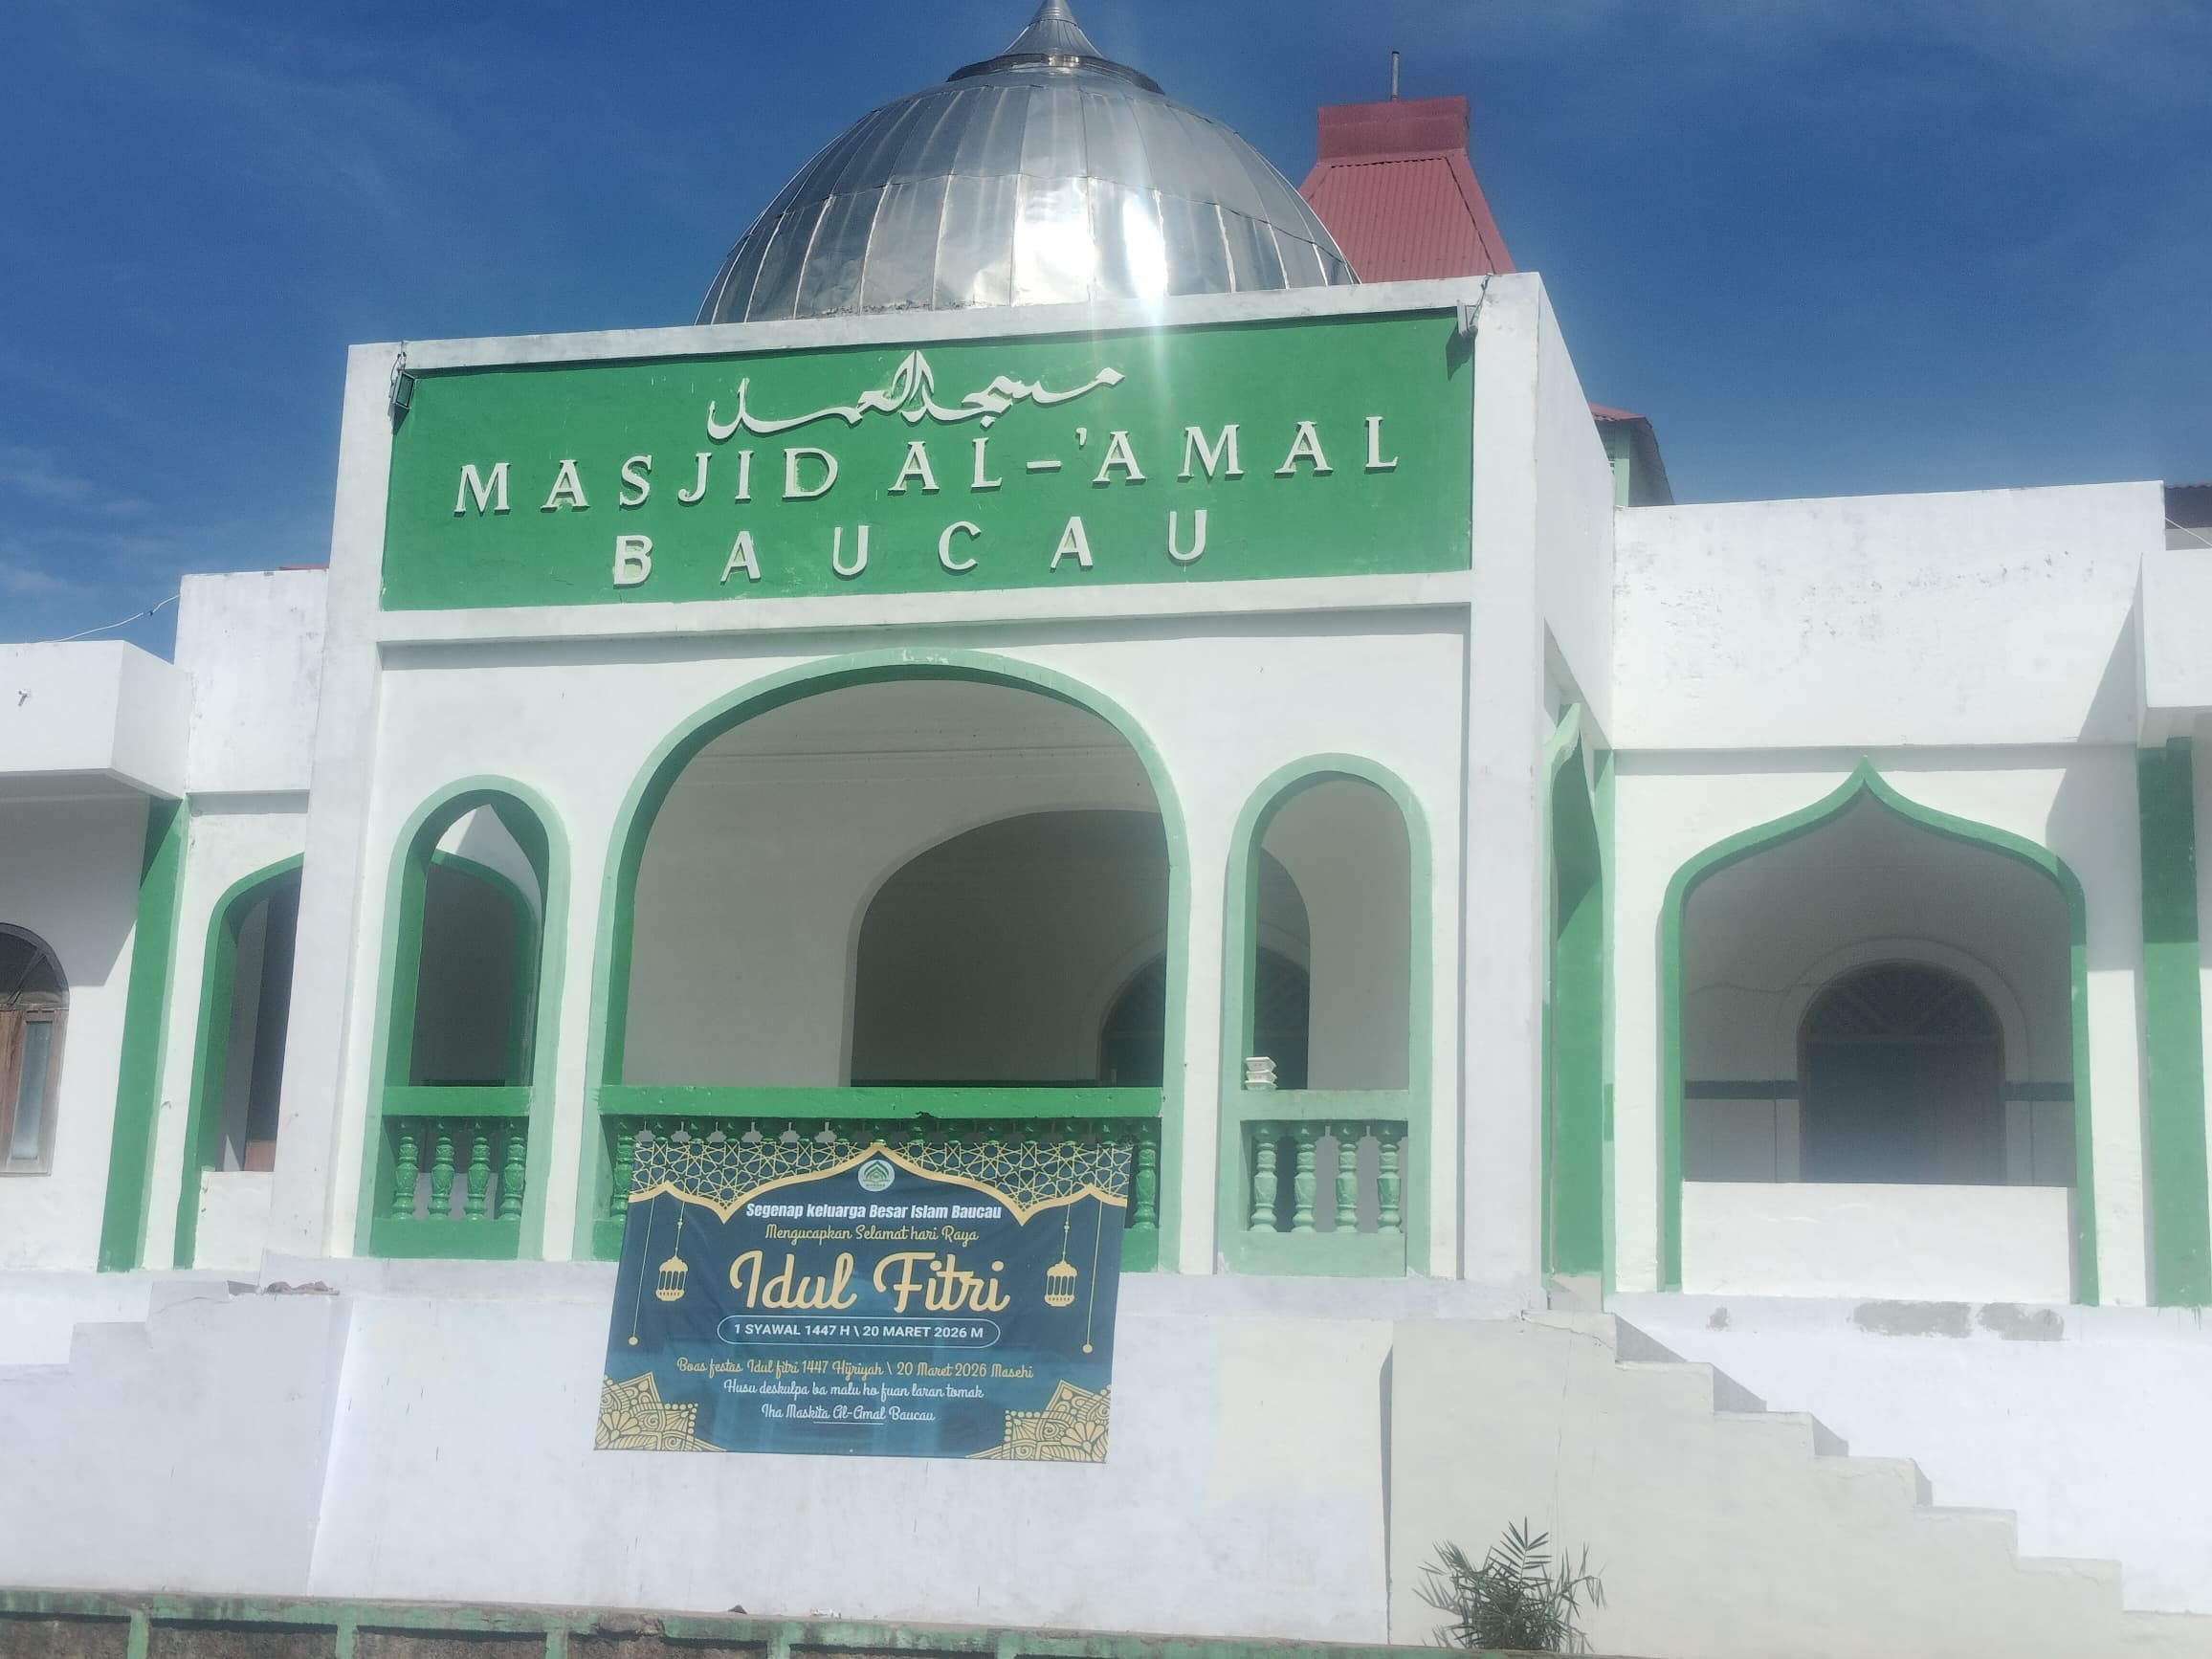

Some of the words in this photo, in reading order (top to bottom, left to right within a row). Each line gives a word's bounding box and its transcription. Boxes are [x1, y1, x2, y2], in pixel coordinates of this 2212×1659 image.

[453, 445, 839, 517] MASJID
[612, 509, 1210, 587] BAUCAU
[746, 1203, 804, 1218] Segenap
[807, 1204, 866, 1220] keluarga
[869, 1205, 908, 1219] Besar
[910, 1205, 948, 1219] Islam
[951, 1206, 1002, 1219] Baucau
[765, 1224, 852, 1246] Mengucapkan
[855, 1225, 910, 1241] Selamat
[911, 1227, 939, 1241] hari
[941, 1226, 979, 1248] Raya
[728, 1250, 858, 1311] Idul
[873, 1251, 1011, 1314] Fitri
[734, 1324, 741, 1335] 1
[744, 1323, 801, 1336] SYAWAL
[805, 1325, 836, 1336] 1447
[839, 1325, 851, 1337] H
[862, 1325, 879, 1337] 20
[882, 1326, 932, 1338] MARET
[933, 1327, 967, 1338] 2026
[970, 1328, 984, 1338] M
[677, 1357, 708, 1372] Boas
[709, 1359, 743, 1378] festas
[746, 1359, 774, 1374] Idul
[775, 1359, 800, 1380] fitri
[802, 1360, 830, 1375] 1447
[896, 1361, 914, 1376] 20
[917, 1361, 954, 1377] Maret
[954, 1362, 987, 1378] 2026
[990, 1363, 1034, 1379] Masehi
[723, 1379, 759, 1394] Husu
[759, 1380, 810, 1402] deskulpa
[812, 1382, 829, 1395] ba
[830, 1382, 861, 1396] malu
[862, 1382, 880, 1397] ho
[880, 1382, 912, 1403] fuan
[911, 1383, 947, 1398] laran
[945, 1383, 984, 1399] tomak
[762, 1404, 784, 1419] Iha
[785, 1404, 830, 1420] Maskita
[832, 1405, 887, 1421] Al-Amal
[888, 1406, 936, 1422] Baucau
